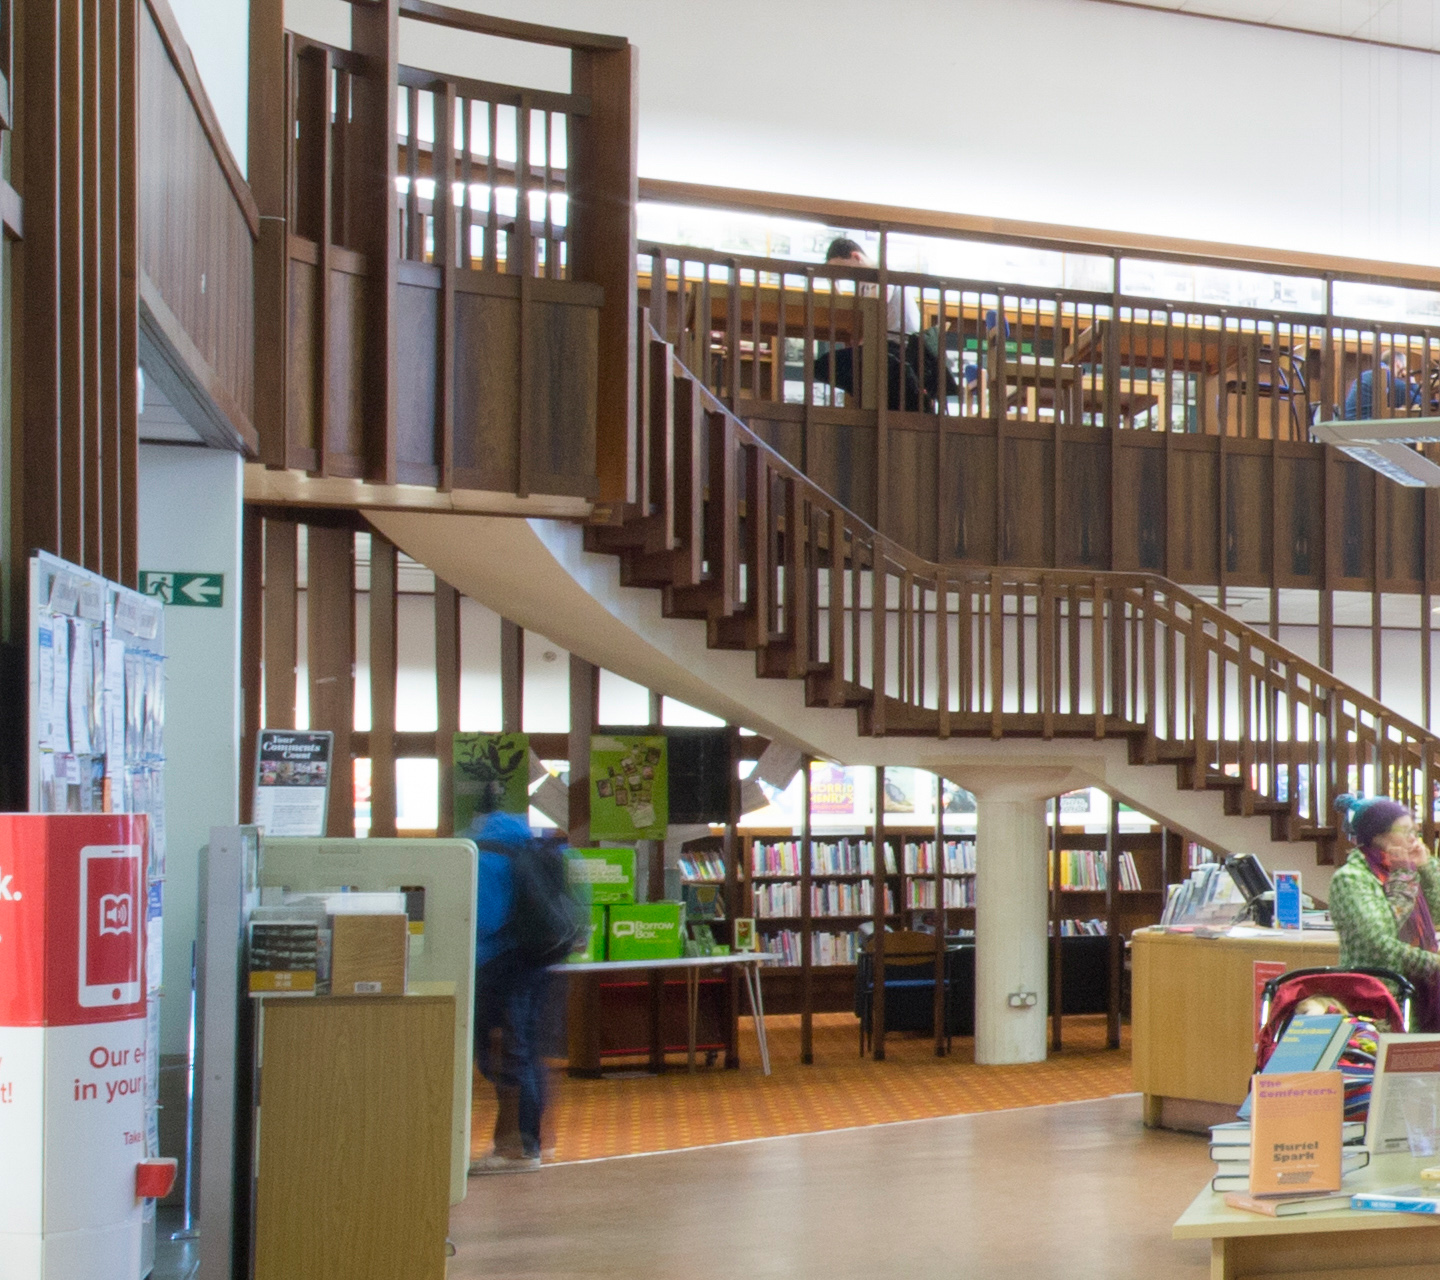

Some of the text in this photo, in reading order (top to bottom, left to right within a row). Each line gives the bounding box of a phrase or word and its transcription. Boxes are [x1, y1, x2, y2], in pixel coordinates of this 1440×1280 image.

[635, 921, 675, 931] Borrow
[89, 1046, 129, 1070] Our
[73, 1076, 142, 1104] in your
[1259, 1079, 1282, 1089] The
[1273, 1141, 1320, 1153] Muriel
[1272, 1150, 1315, 1163] Spark
